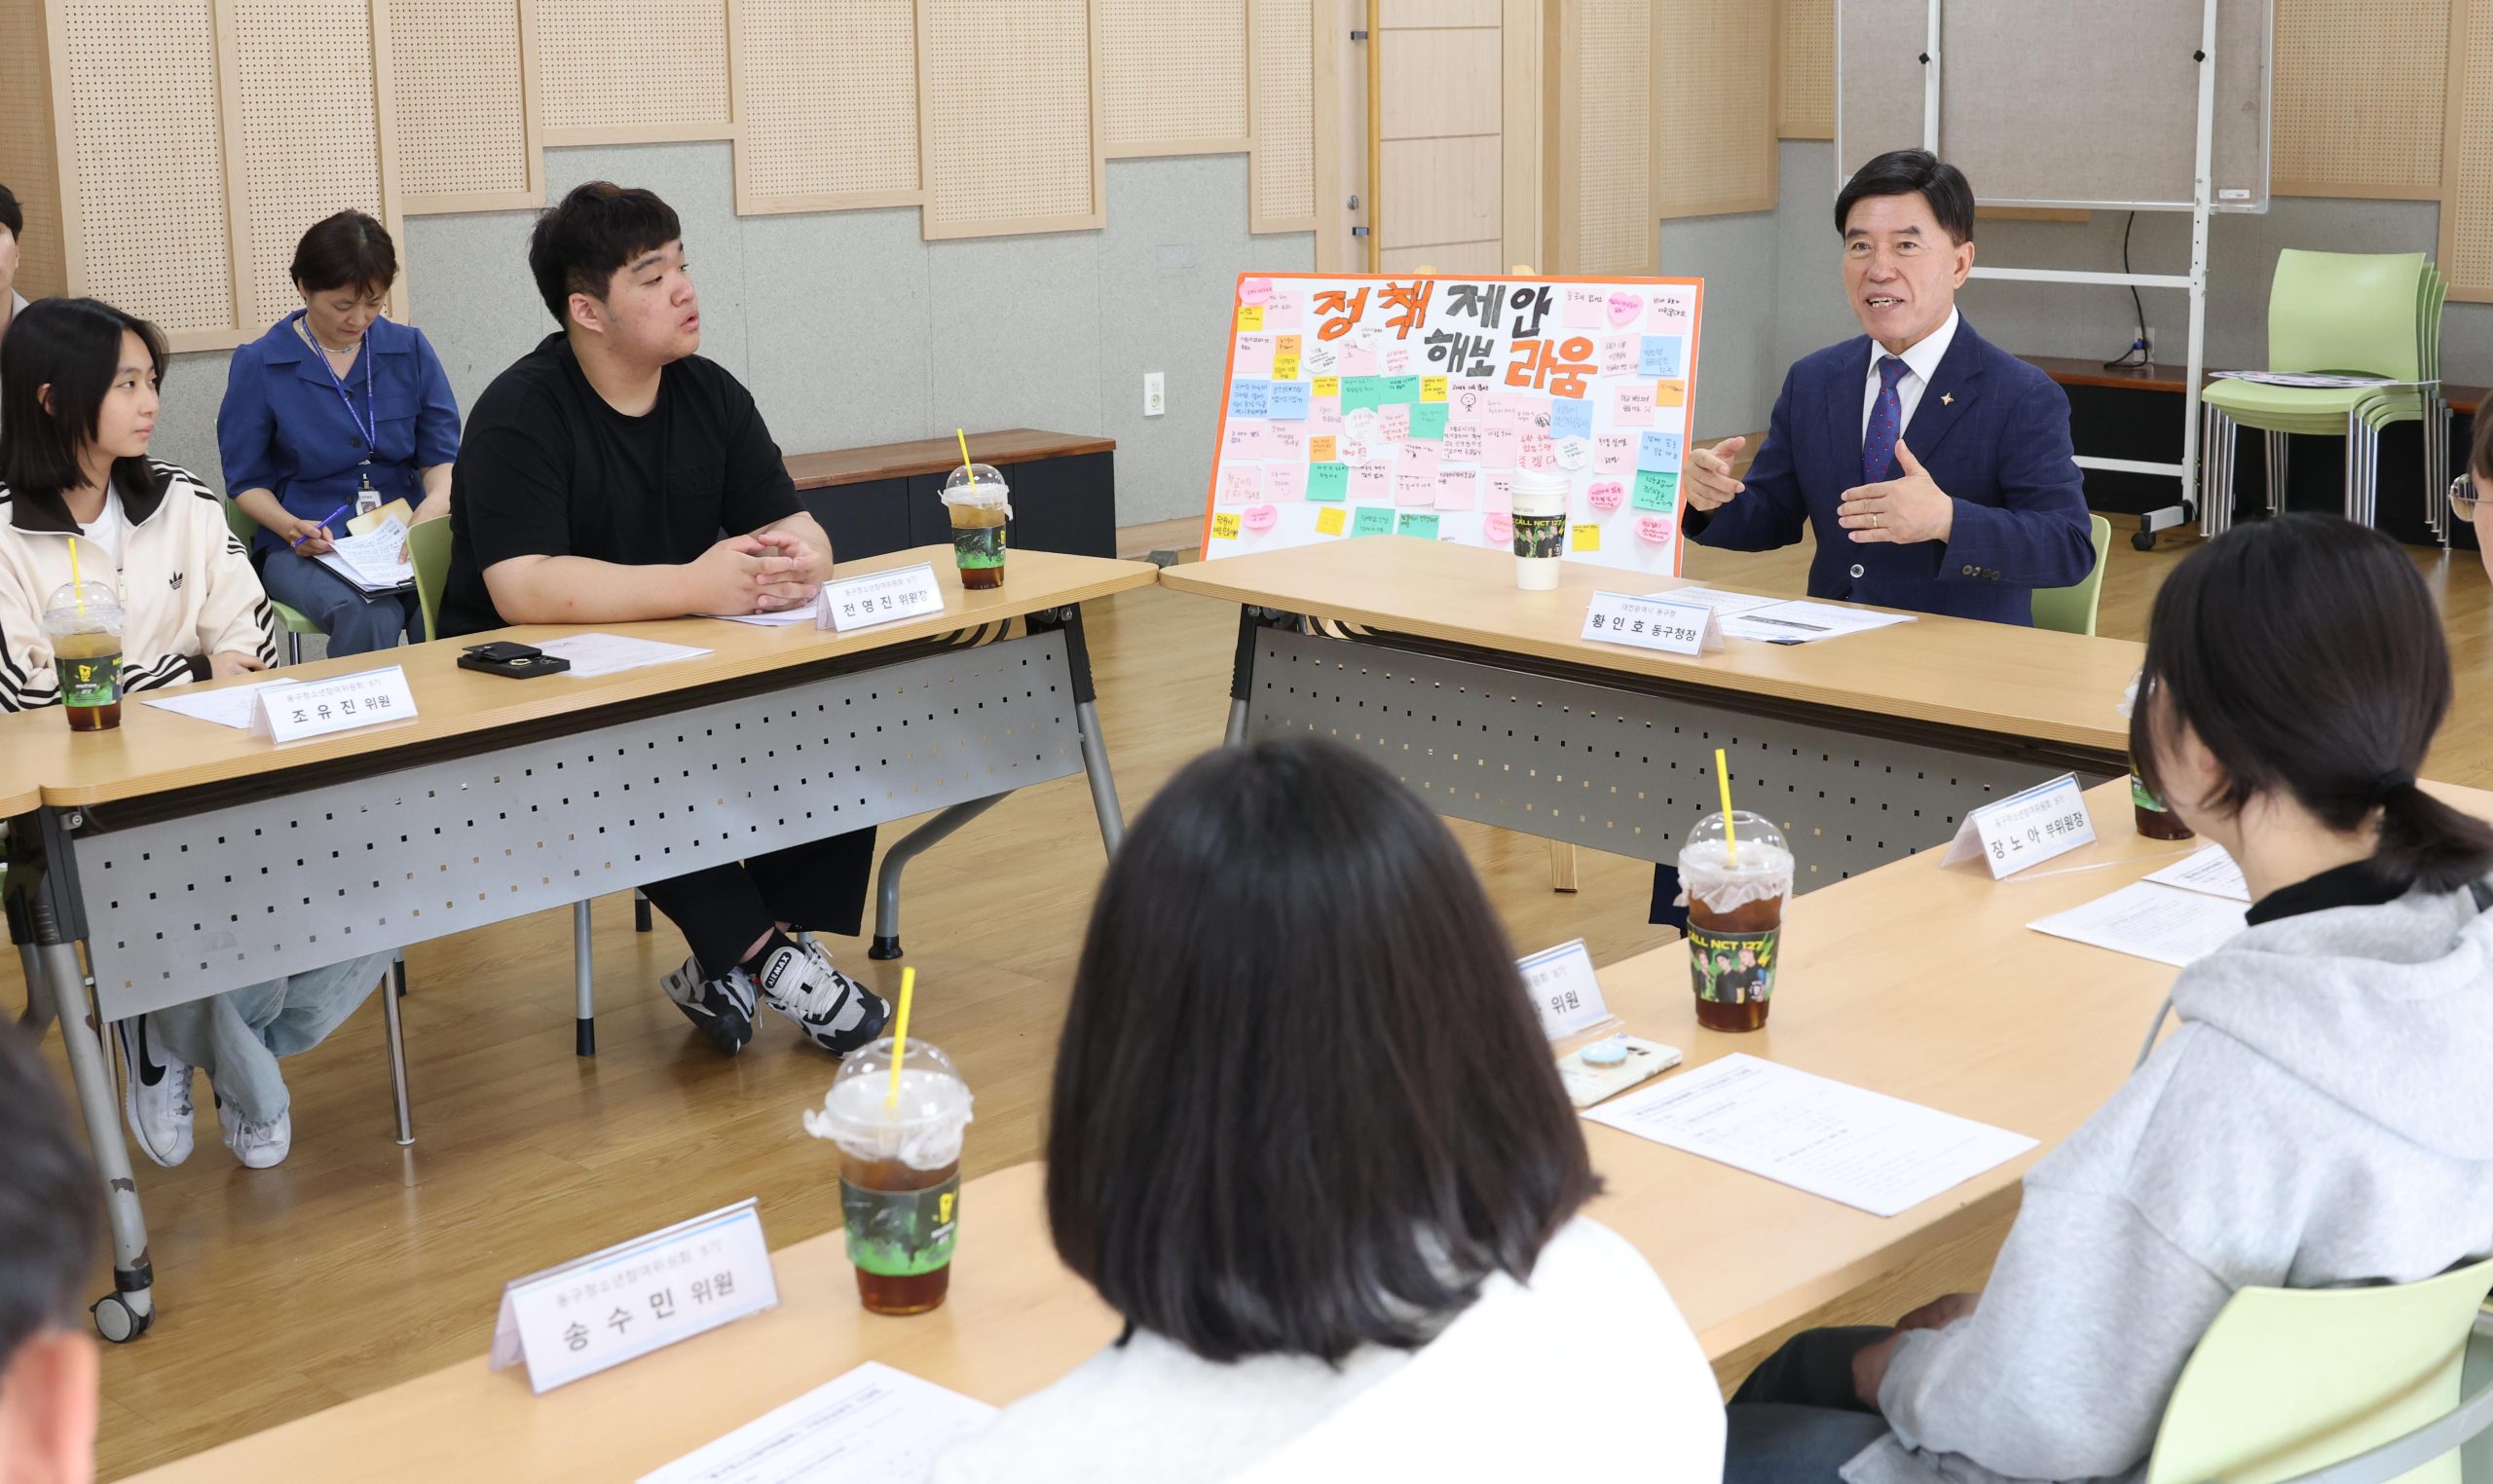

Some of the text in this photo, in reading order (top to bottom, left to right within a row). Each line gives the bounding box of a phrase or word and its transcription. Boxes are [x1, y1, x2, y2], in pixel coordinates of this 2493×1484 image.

[1445, 284, 1552, 339] 제안
[899, 590, 928, 606] 위원장
[1652, 624, 1696, 642] 동구청장
[364, 694, 391, 710] 위원
[2046, 810, 2084, 838] 부위원장
[1710, 939, 1738, 950] NCT
[1741, 941, 1764, 950] 127
[1550, 990, 1581, 1014] 위원
[690, 1271, 734, 1304] 위원
